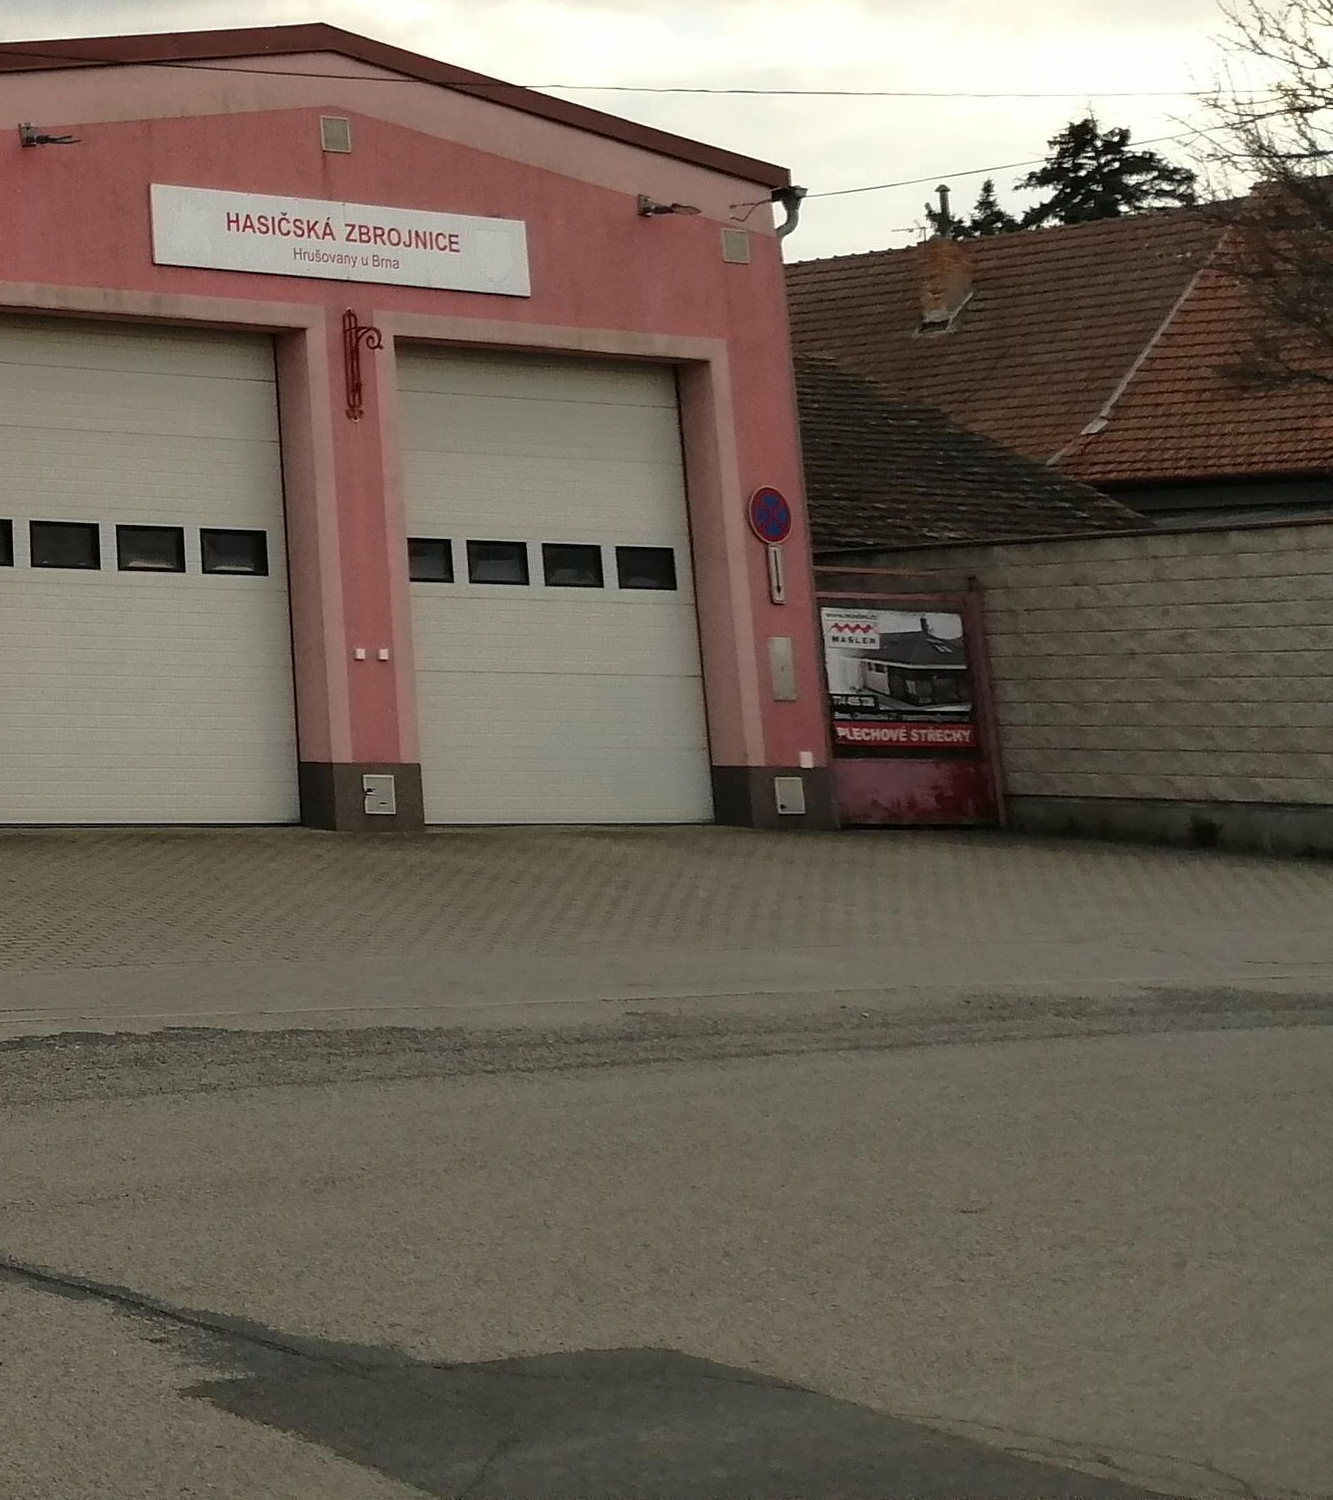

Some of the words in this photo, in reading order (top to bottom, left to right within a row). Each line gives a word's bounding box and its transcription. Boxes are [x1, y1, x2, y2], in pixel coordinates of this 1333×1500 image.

[225, 211, 336, 241] HASIČSKÁ
[344, 222, 461, 253] ZBROJNICE
[293, 247, 358, 268] Hrušovany
[361, 255, 369, 267] u
[372, 254, 400, 269] Brna
[836, 725, 907, 742] PLECHOVÉ
[910, 726, 971, 743] STŘECHY
